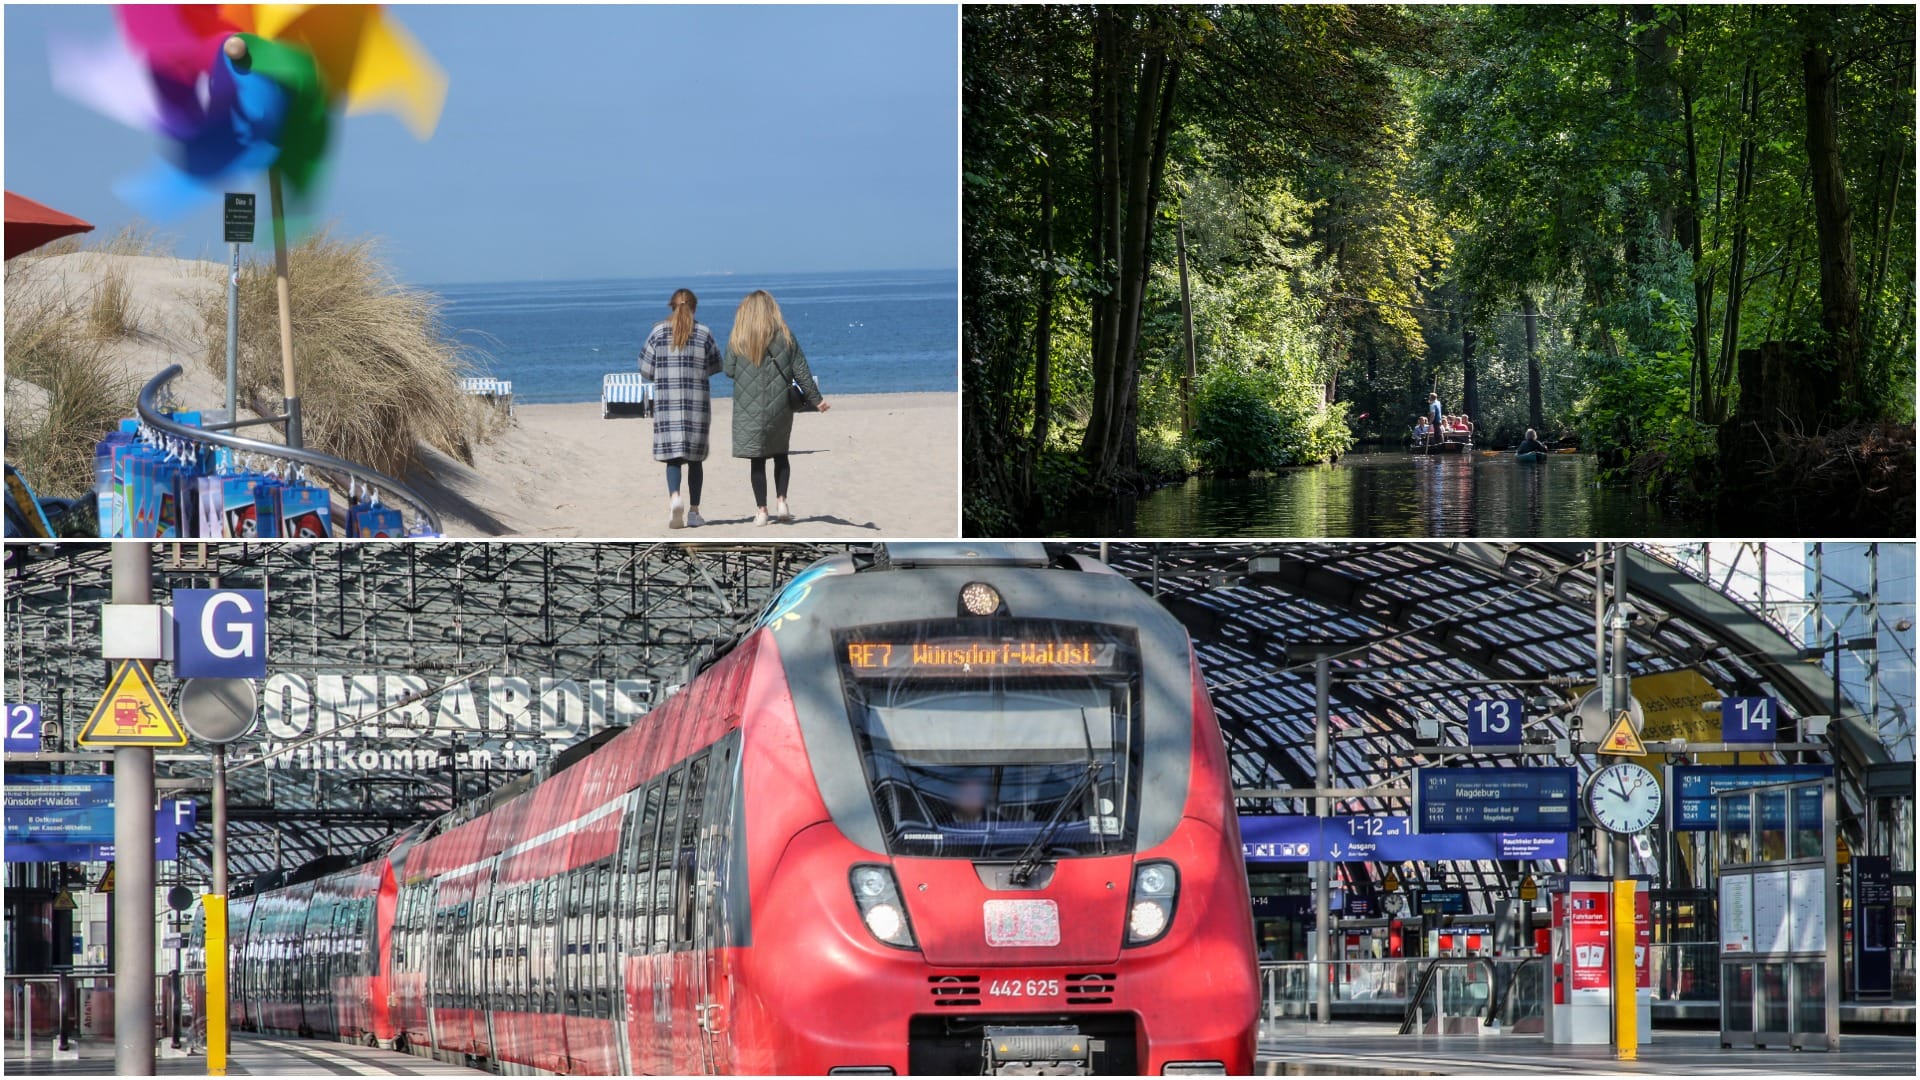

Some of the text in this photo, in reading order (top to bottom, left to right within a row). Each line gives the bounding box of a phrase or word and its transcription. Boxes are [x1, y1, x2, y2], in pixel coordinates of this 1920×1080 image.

[201, 592, 254, 658] G
[848, 643, 1096, 668] RE7 Wünsdorf-Waldst.
[248, 674, 650, 738] OMBARDIE
[1474, 701, 1511, 734] 13
[1734, 699, 1772, 731] 14
[504, 741, 537, 770] in
[1455, 788, 1500, 798] Magdeburg
[175, 800, 191, 825] F
[1347, 818, 1383, 835] 1-12
[1386, 828, 1399, 836] und
[1347, 843, 1376, 851] Ausgang
[990, 980, 1059, 997] 442 625
